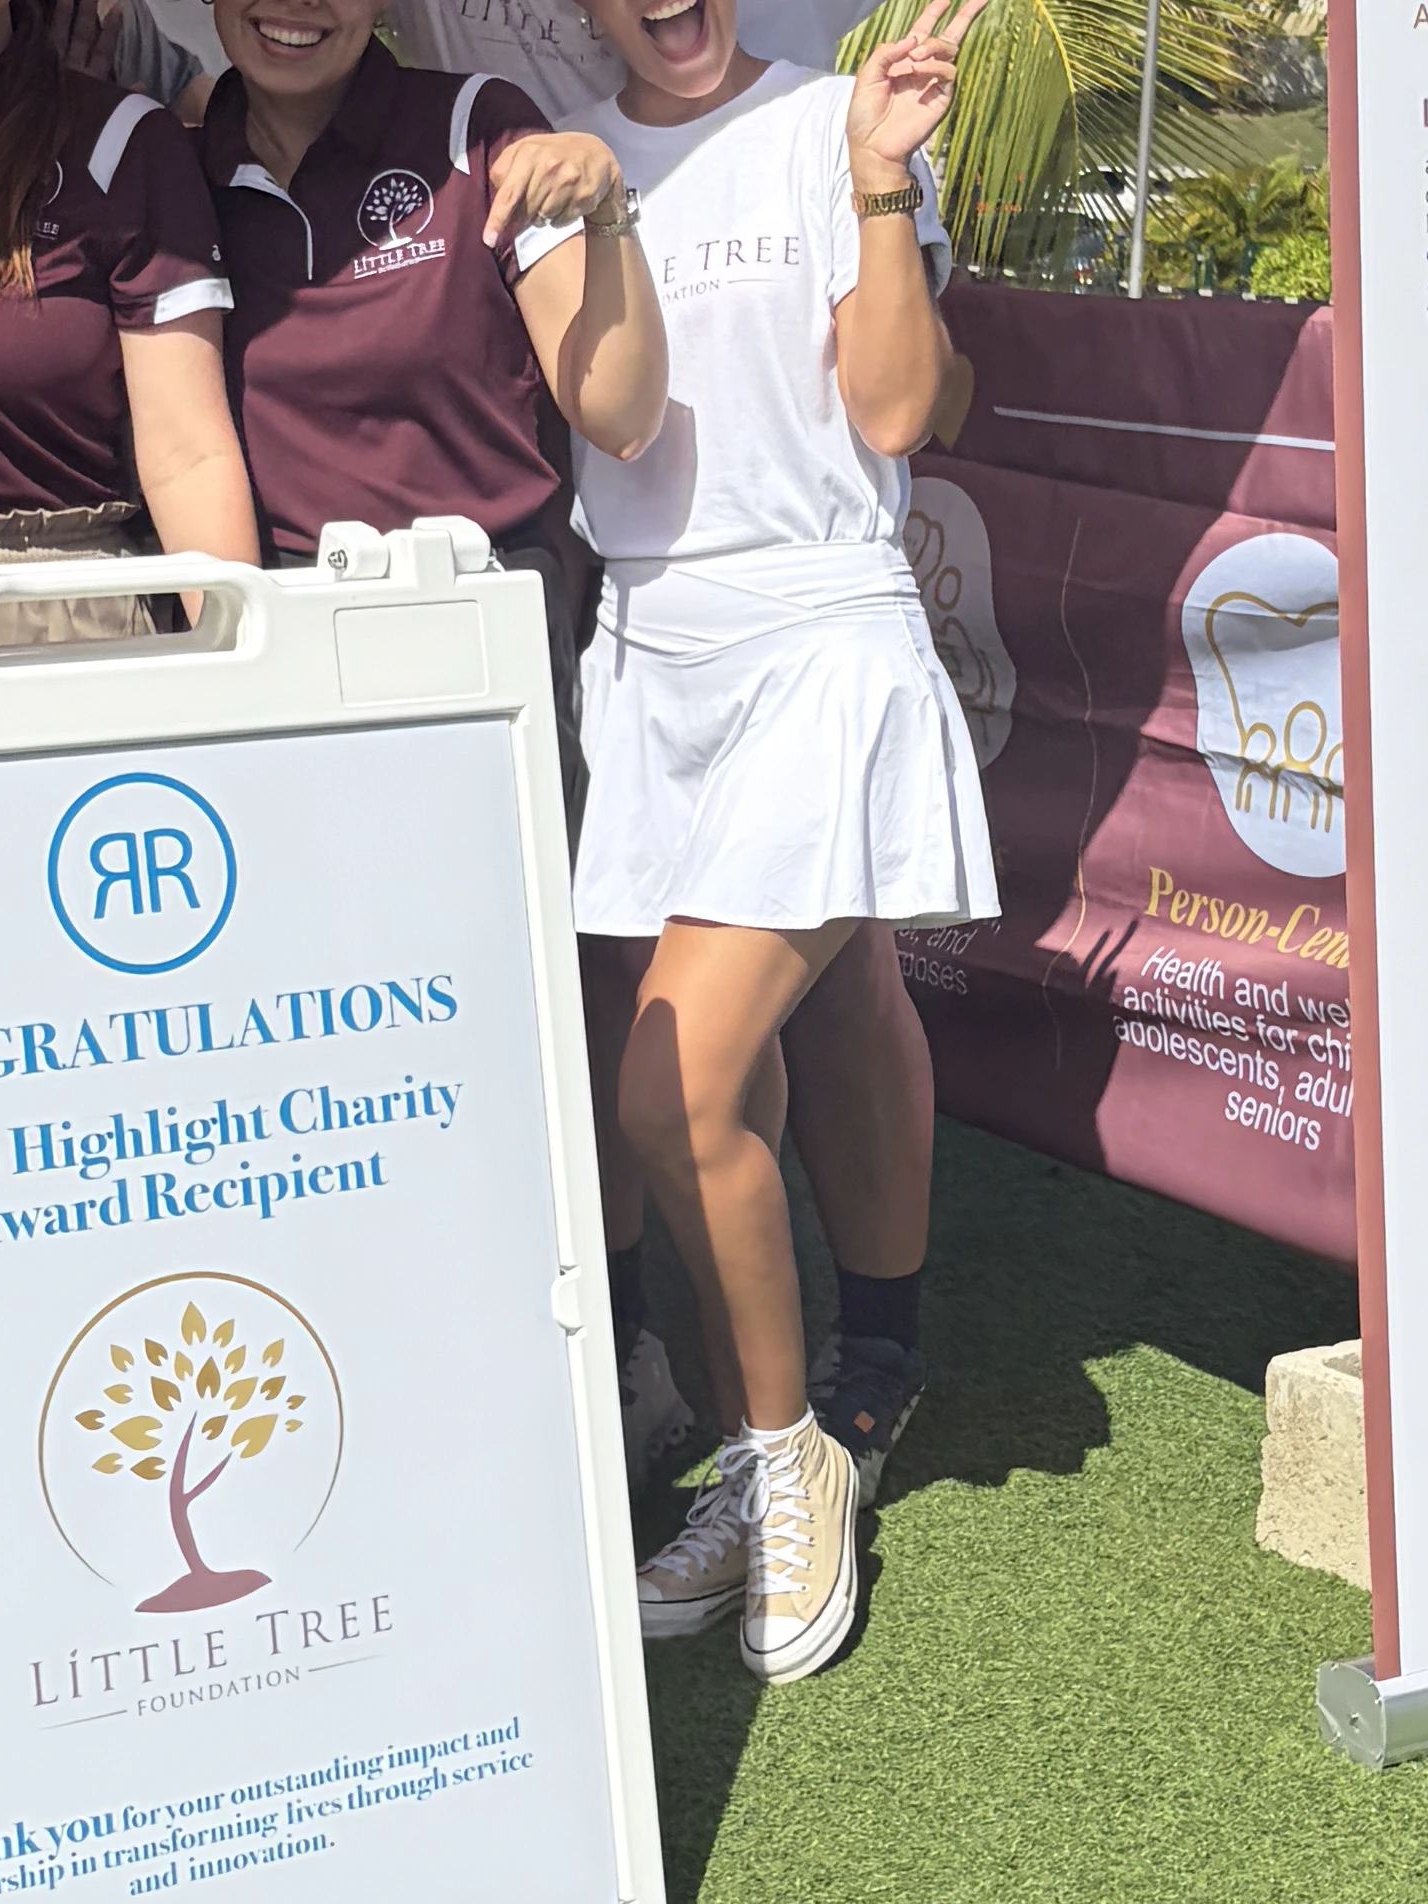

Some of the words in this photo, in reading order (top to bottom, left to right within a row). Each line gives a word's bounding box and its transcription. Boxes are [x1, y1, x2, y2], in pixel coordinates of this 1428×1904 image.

[697, 235, 801, 272] TREE
[1144, 866, 1349, 969] Person-Cen
[1141, 946, 1225, 999] Health
[1235, 978, 1288, 1017] and
[1124, 986, 1250, 1041] activities
[1257, 1014, 1299, 1054] for
[1114, 1015, 1285, 1105] adolescents,
[1295, 1070, 1353, 1117] adul
[9, 1099, 271, 1180] Highlight
[279, 1075, 462, 1134] Charity
[1225, 1091, 1322, 1150] seniors
[141, 1152, 386, 1221] Recipient
[256, 1594, 394, 1656] TREE
[136, 1665, 302, 1717] FOUNDATION
[123, 1806, 161, 1832] for
[164, 1793, 225, 1827] your
[231, 1755, 384, 1805] outstanding
[387, 1734, 471, 1768] impact
[476, 1716, 519, 1749] and
[45, 1813, 117, 1860] you
[103, 1813, 279, 1868] transforming
[287, 1798, 342, 1825] lives
[348, 1767, 447, 1810] through
[452, 1751, 533, 1786] service
[130, 1861, 178, 1896] and
[189, 1834, 335, 1881] innovation.
